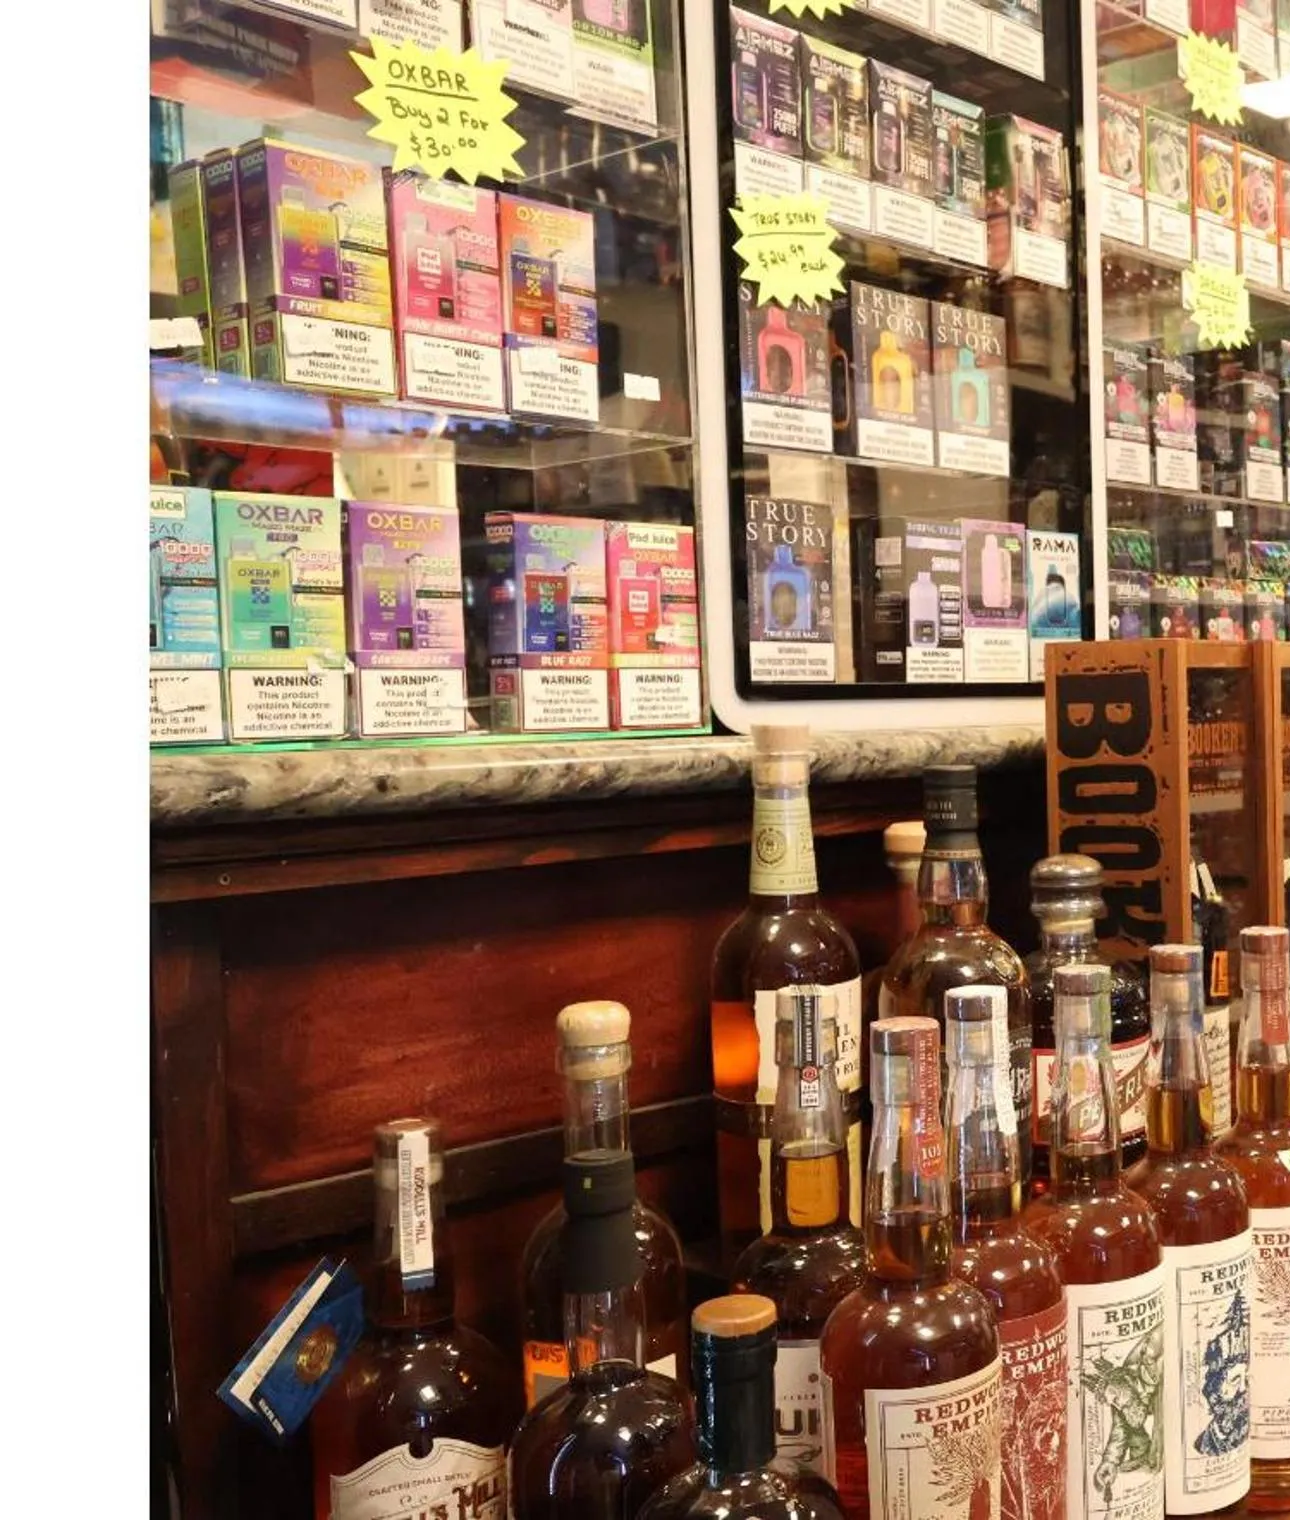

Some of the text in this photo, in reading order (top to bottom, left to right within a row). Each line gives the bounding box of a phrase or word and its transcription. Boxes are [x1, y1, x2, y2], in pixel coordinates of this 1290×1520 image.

[387, 60, 470, 92] OXBAR
[387, 97, 432, 129] Buy
[436, 108, 450, 126] 2
[857, 286, 916, 317] TRUE
[857, 308, 926, 341] STORY
[938, 304, 993, 333] TRUE
[937, 326, 1003, 356] STORY
[150, 501, 183, 513] uice
[236, 503, 323, 526] OXBAR
[748, 499, 816, 526] TRUE
[150, 522, 184, 535] BAR
[367, 512, 443, 531] OXBAR
[746, 521, 827, 548] STORY
[1031, 537, 1077, 554] RAMA
[237, 568, 280, 579] OXBAR
[541, 656, 566, 667] BLUE
[252, 675, 323, 689] WARNING:
[541, 675, 592, 686] WARNING:
[635, 674, 683, 684] WARNING:
[258, 690, 320, 702] This product
[246, 700, 330, 711] contains Nicotine
[256, 711, 297, 721] Nicotine
[242, 721, 333, 732] addictive chemical
[1056, 672, 1168, 945] BOOK
